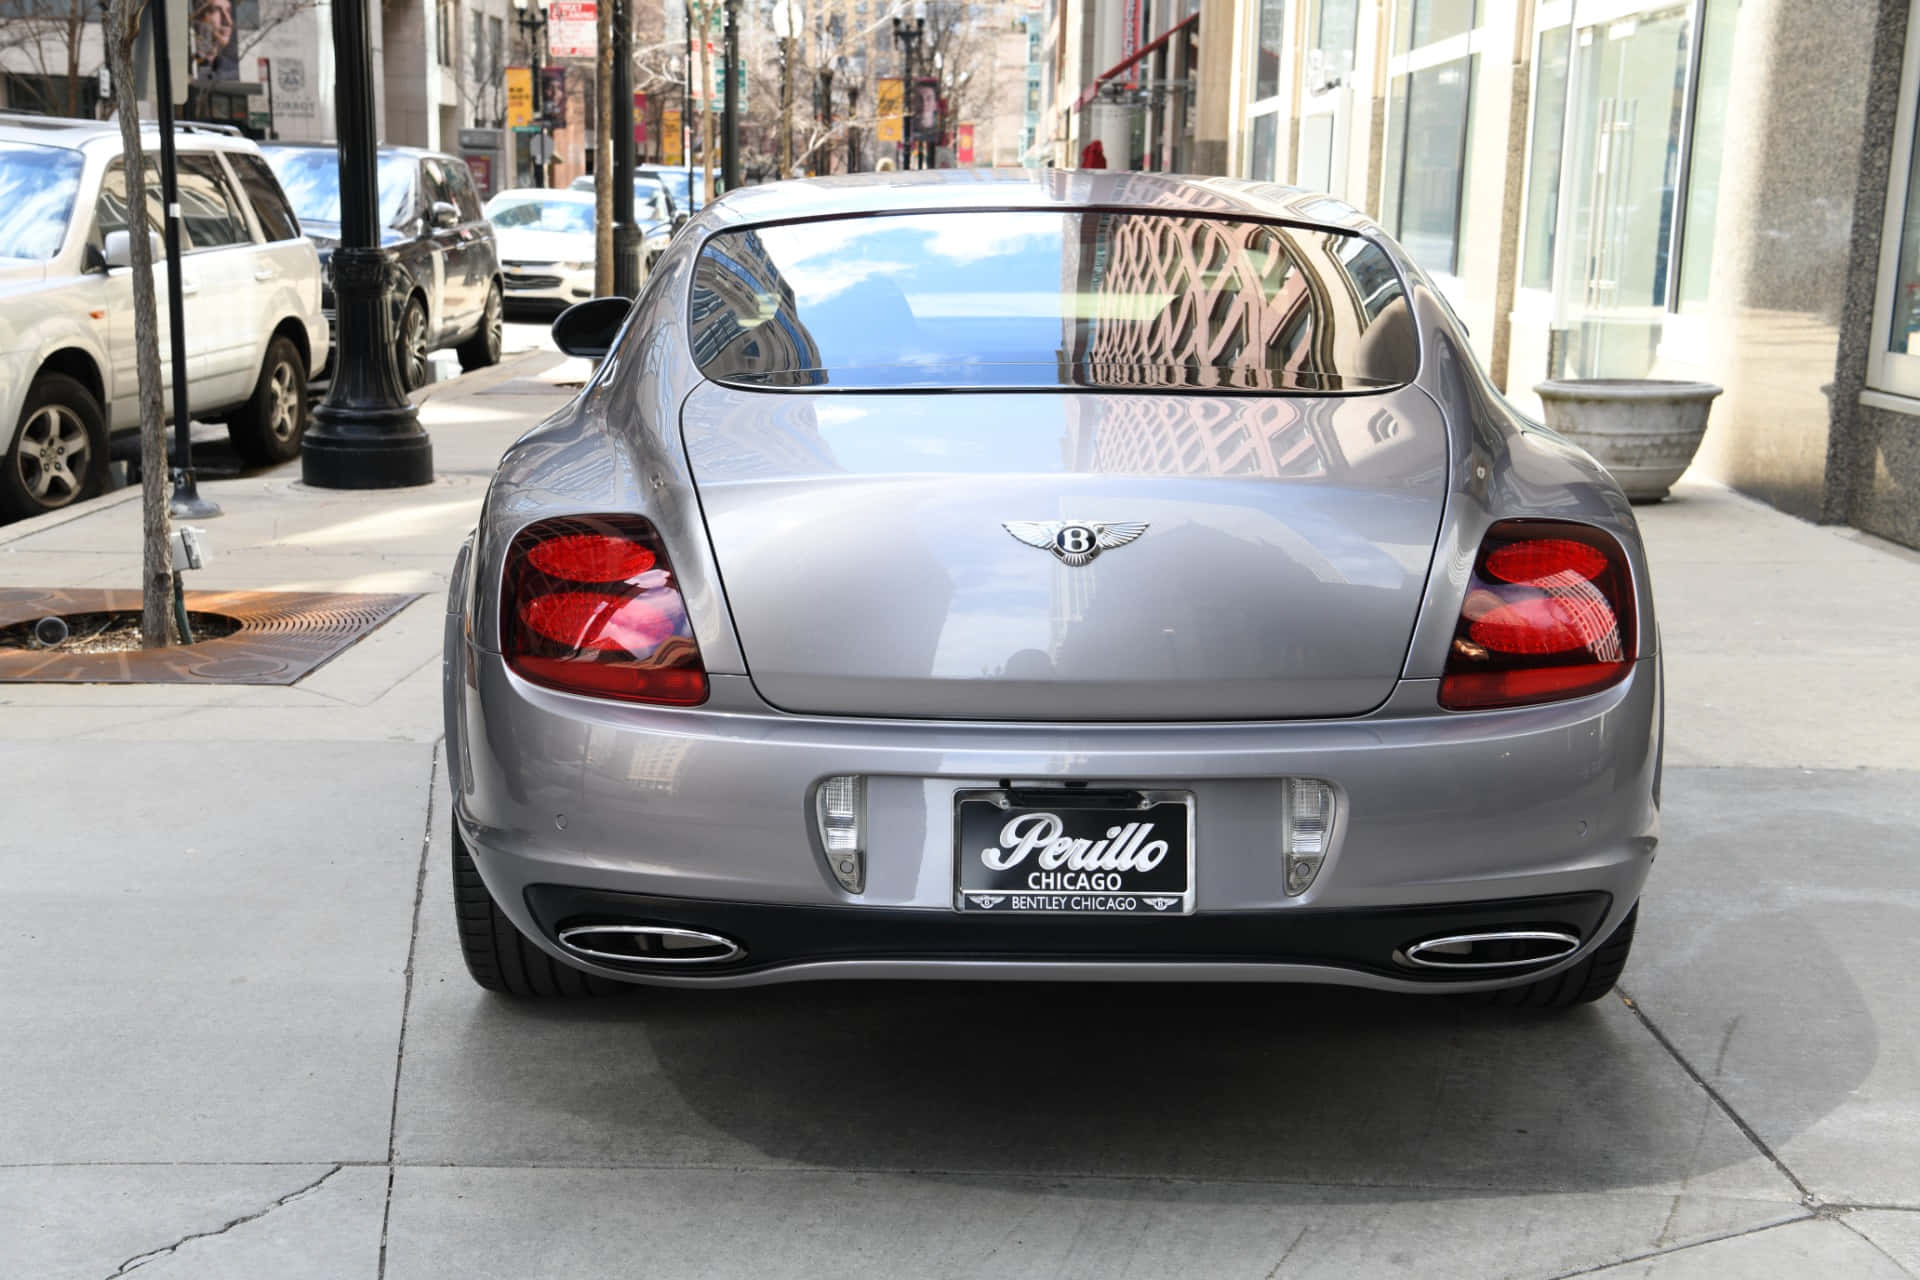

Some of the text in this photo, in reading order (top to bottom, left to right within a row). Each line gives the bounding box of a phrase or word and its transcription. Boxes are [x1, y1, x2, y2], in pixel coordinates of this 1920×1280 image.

[1063, 527, 1090, 552] B
[981, 812, 1168, 872] Perillo
[1028, 872, 1122, 890] CHICAGO
[1012, 896, 1137, 911] BENTLEY CHICAGO
